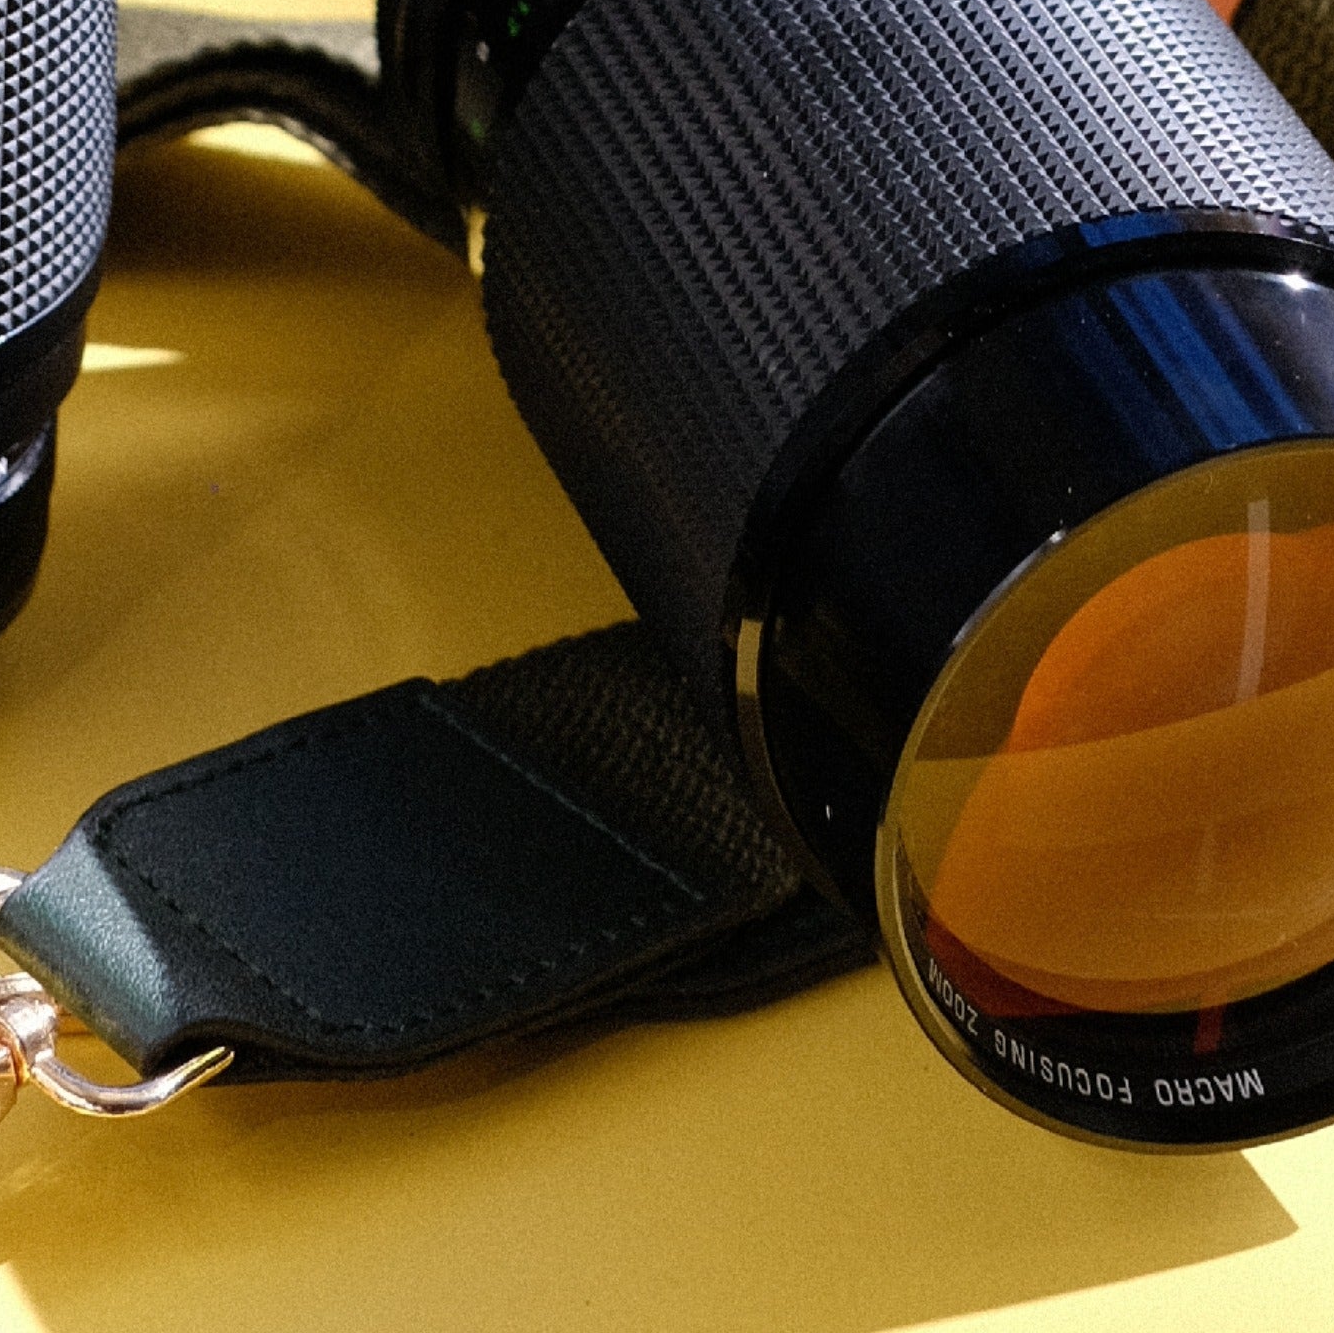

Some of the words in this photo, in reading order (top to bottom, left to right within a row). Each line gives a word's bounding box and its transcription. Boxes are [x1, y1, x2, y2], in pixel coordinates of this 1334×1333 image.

[926, 956, 980, 1038] ZOOM
[993, 1029, 1134, 1104] FOCUSING
[1153, 1066, 1266, 1107] MACRO
